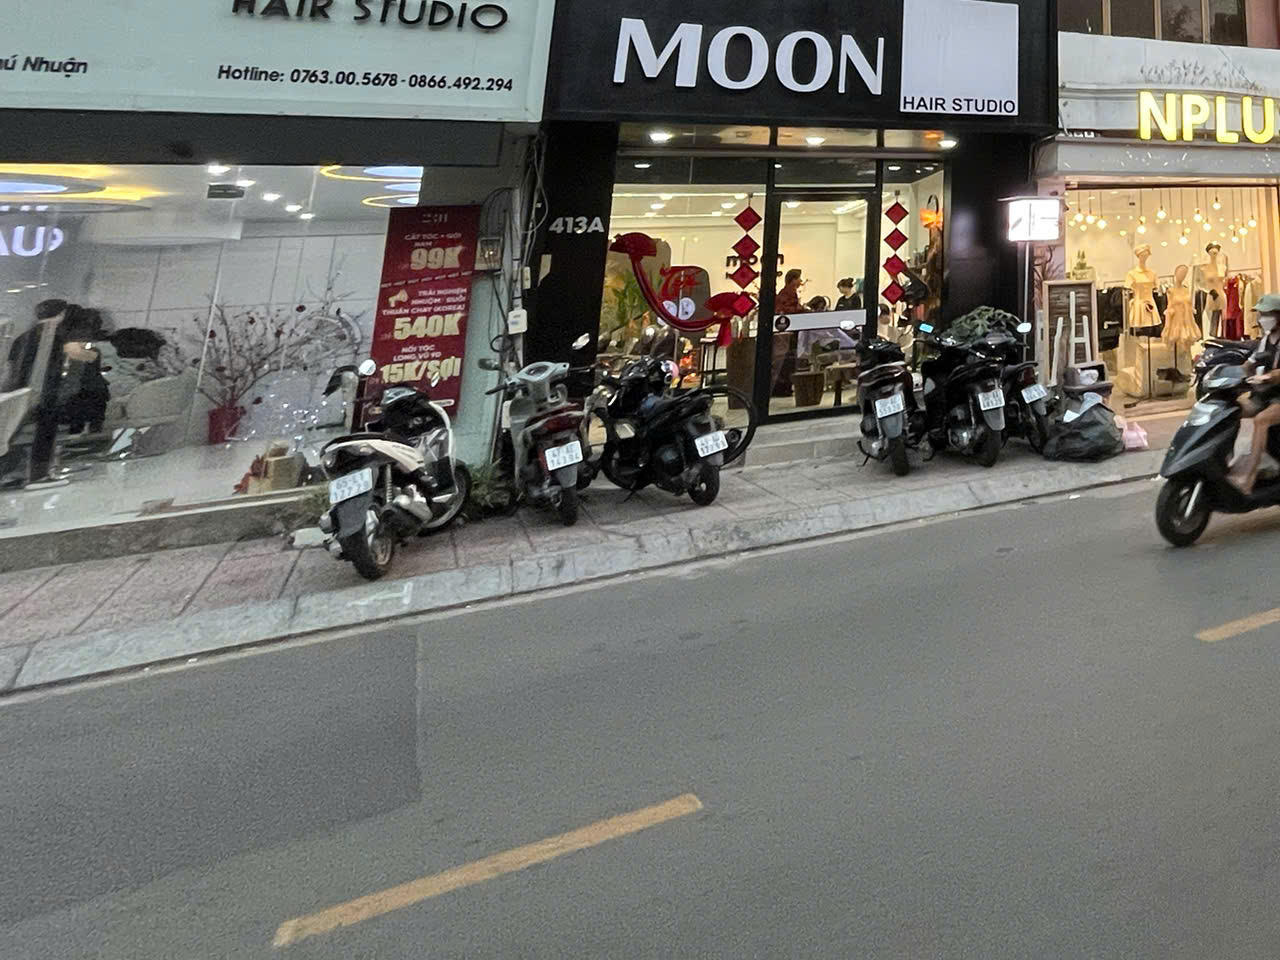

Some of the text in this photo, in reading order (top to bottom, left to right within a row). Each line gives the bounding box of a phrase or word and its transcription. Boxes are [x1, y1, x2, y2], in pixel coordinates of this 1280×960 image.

[22, 56, 88, 78] Nhuận
[612, 17, 885, 96] MOON
[217, 65, 285, 83] Hotline:
[903, 96, 1016, 113] HAIR STUDIO
[549, 216, 604, 234] 413A
[410, 245, 463, 270] 99K
[393, 312, 465, 340] 540K
